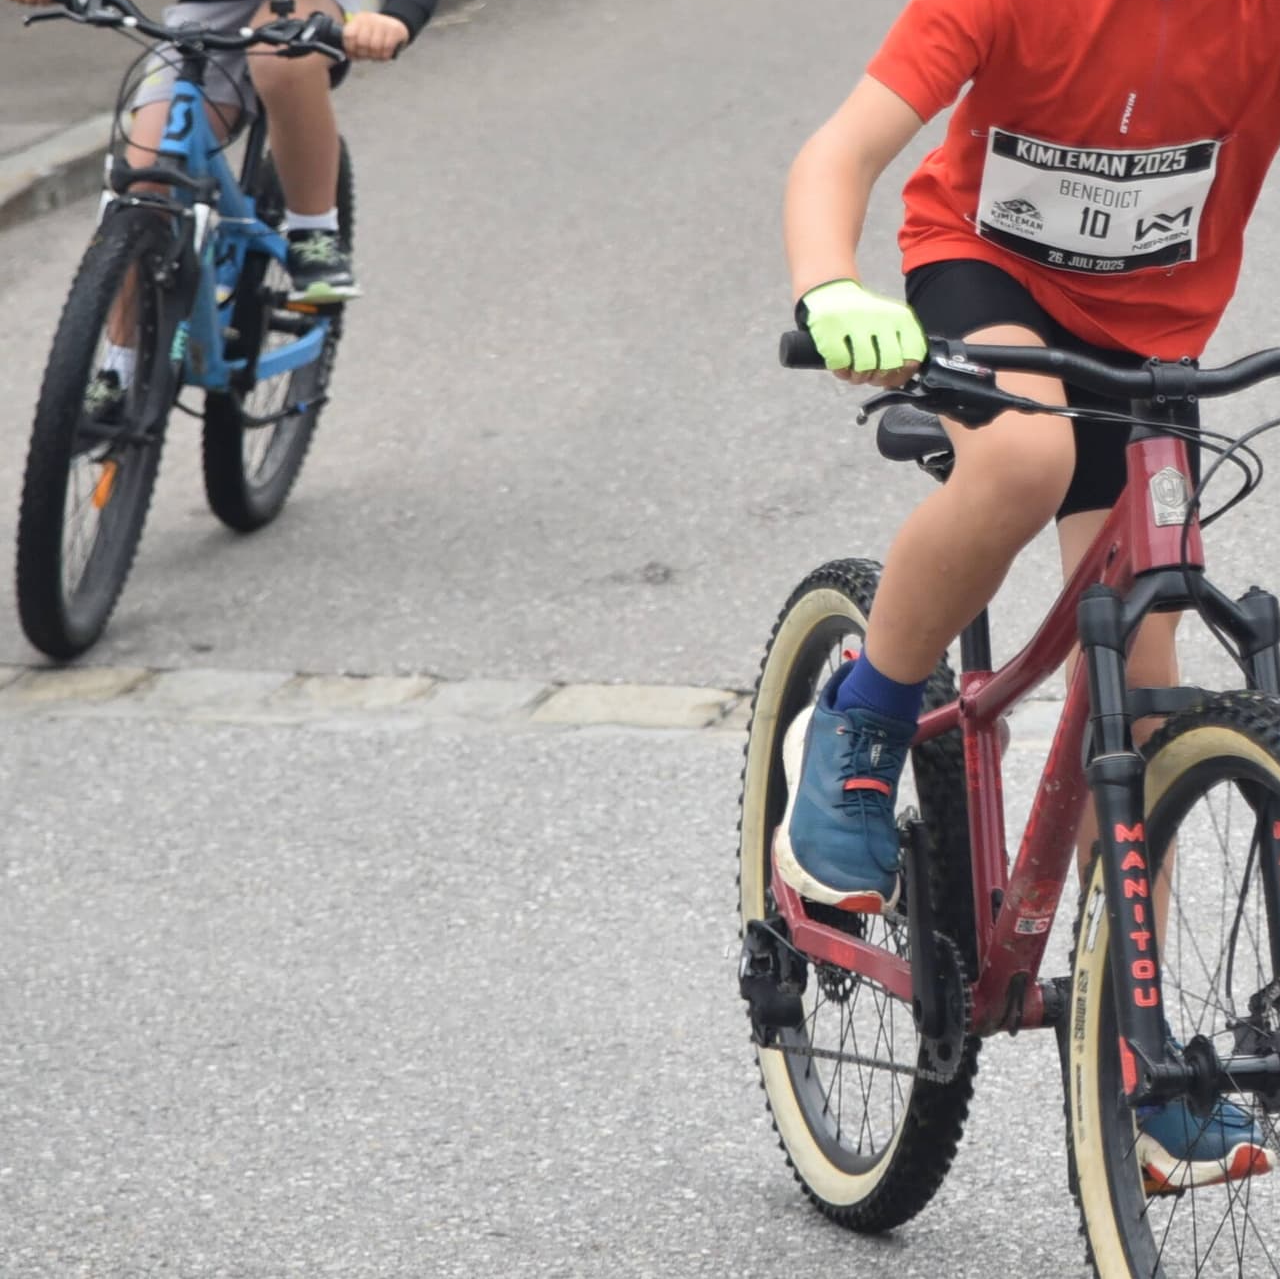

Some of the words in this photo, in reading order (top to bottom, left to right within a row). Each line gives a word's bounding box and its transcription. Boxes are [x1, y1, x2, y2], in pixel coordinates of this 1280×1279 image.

[1016, 139, 1127, 177] KIMLEMAN
[1131, 149, 1188, 176] 2025
[1060, 179, 1142, 209] BENEDICT
[991, 209, 1044, 231] KIMLEMAN
[1080, 206, 1111, 239] 10
[1048, 250, 1066, 265] 26.
[1068, 256, 1094, 269] JULI
[1095, 259, 1126, 271] 2025
[1114, 823, 1159, 1008] MANITOU
